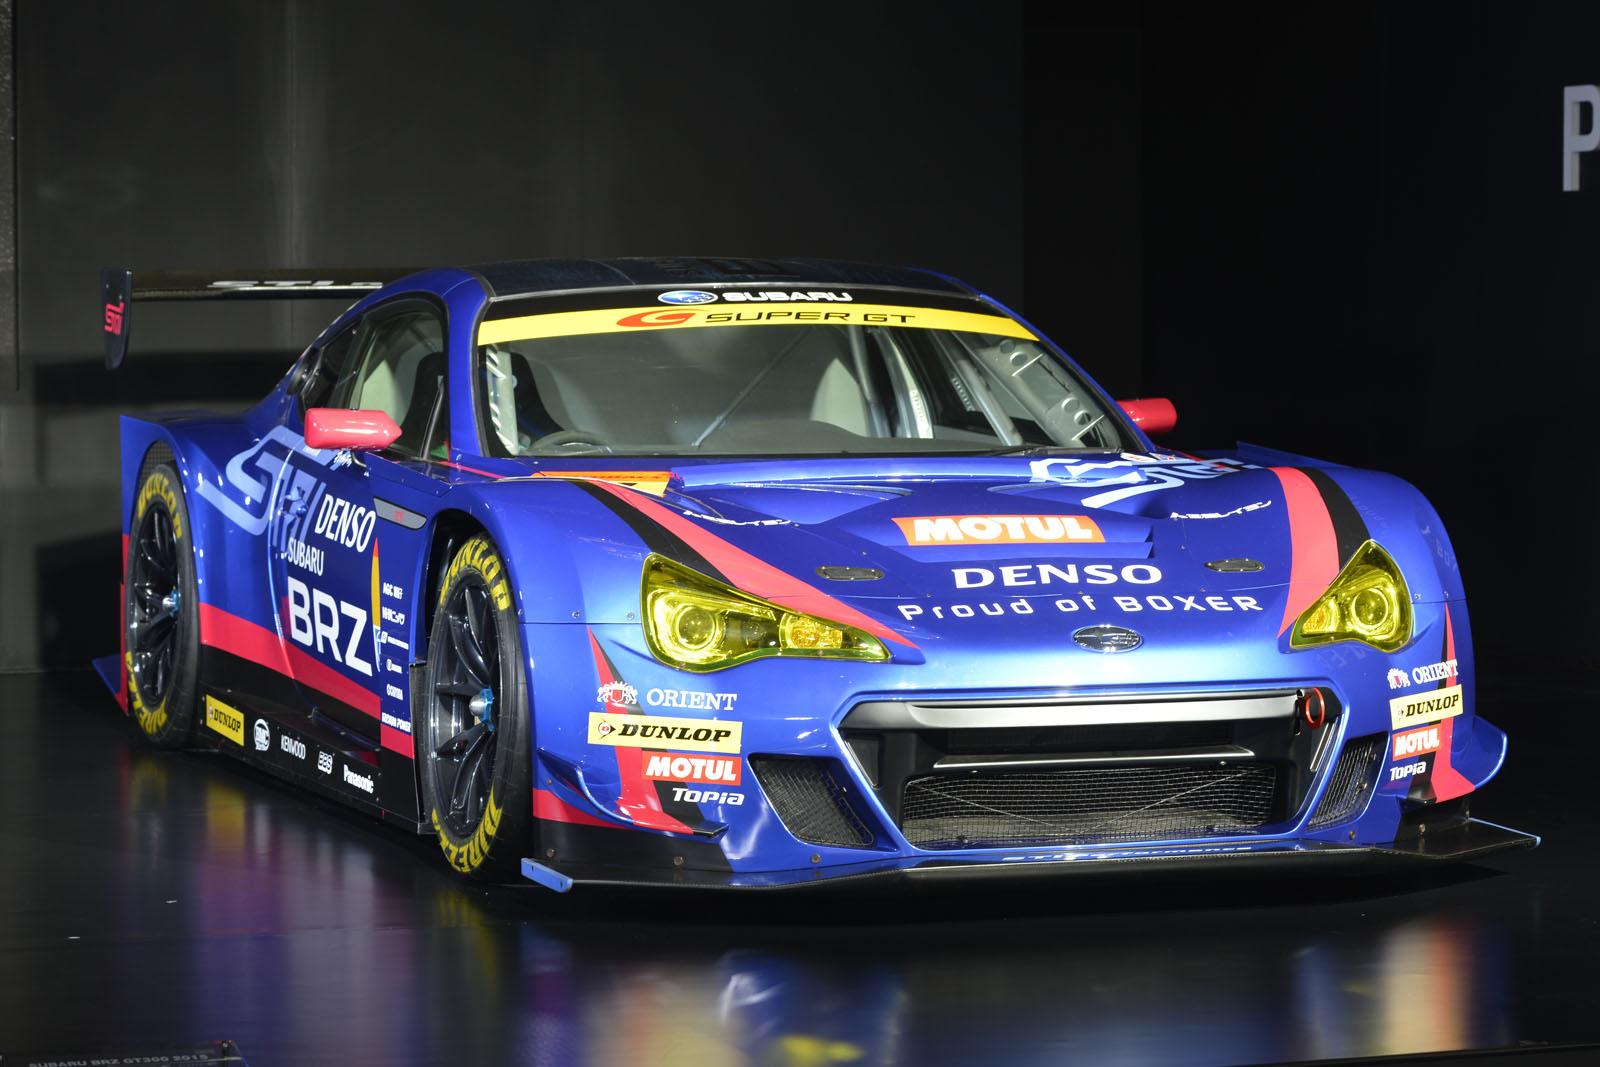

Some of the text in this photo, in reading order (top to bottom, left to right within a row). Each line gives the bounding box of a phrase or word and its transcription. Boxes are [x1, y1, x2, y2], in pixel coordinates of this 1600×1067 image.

[722, 292, 853, 301] SUBARU
[706, 311, 850, 323] SUPER
[863, 313, 915, 323] GT
[315, 494, 376, 552] DENSO
[915, 517, 1093, 542] MOTUL
[288, 537, 324, 576] SUBARU
[441, 539, 510, 609] DUNLOP
[952, 563, 1162, 589] DENSO
[897, 596, 1263, 621] Proud of BOXER
[287, 576, 373, 677] BRZ
[1412, 659, 1459, 685] ORIENT
[646, 688, 737, 711] ORIENT
[1406, 694, 1459, 717] DUNLOP
[214, 709, 241, 733] DUNLOP
[618, 723, 731, 742] DUNLOP
[281, 734, 306, 760] KENWOOD
[1394, 728, 1440, 757] MOTUL
[344, 764, 374, 794] Panasonic
[646, 756, 737, 781] MOTUL
[91, 1058, 119, 1066] BRZ
[123, 1056, 169, 1064] GT300
